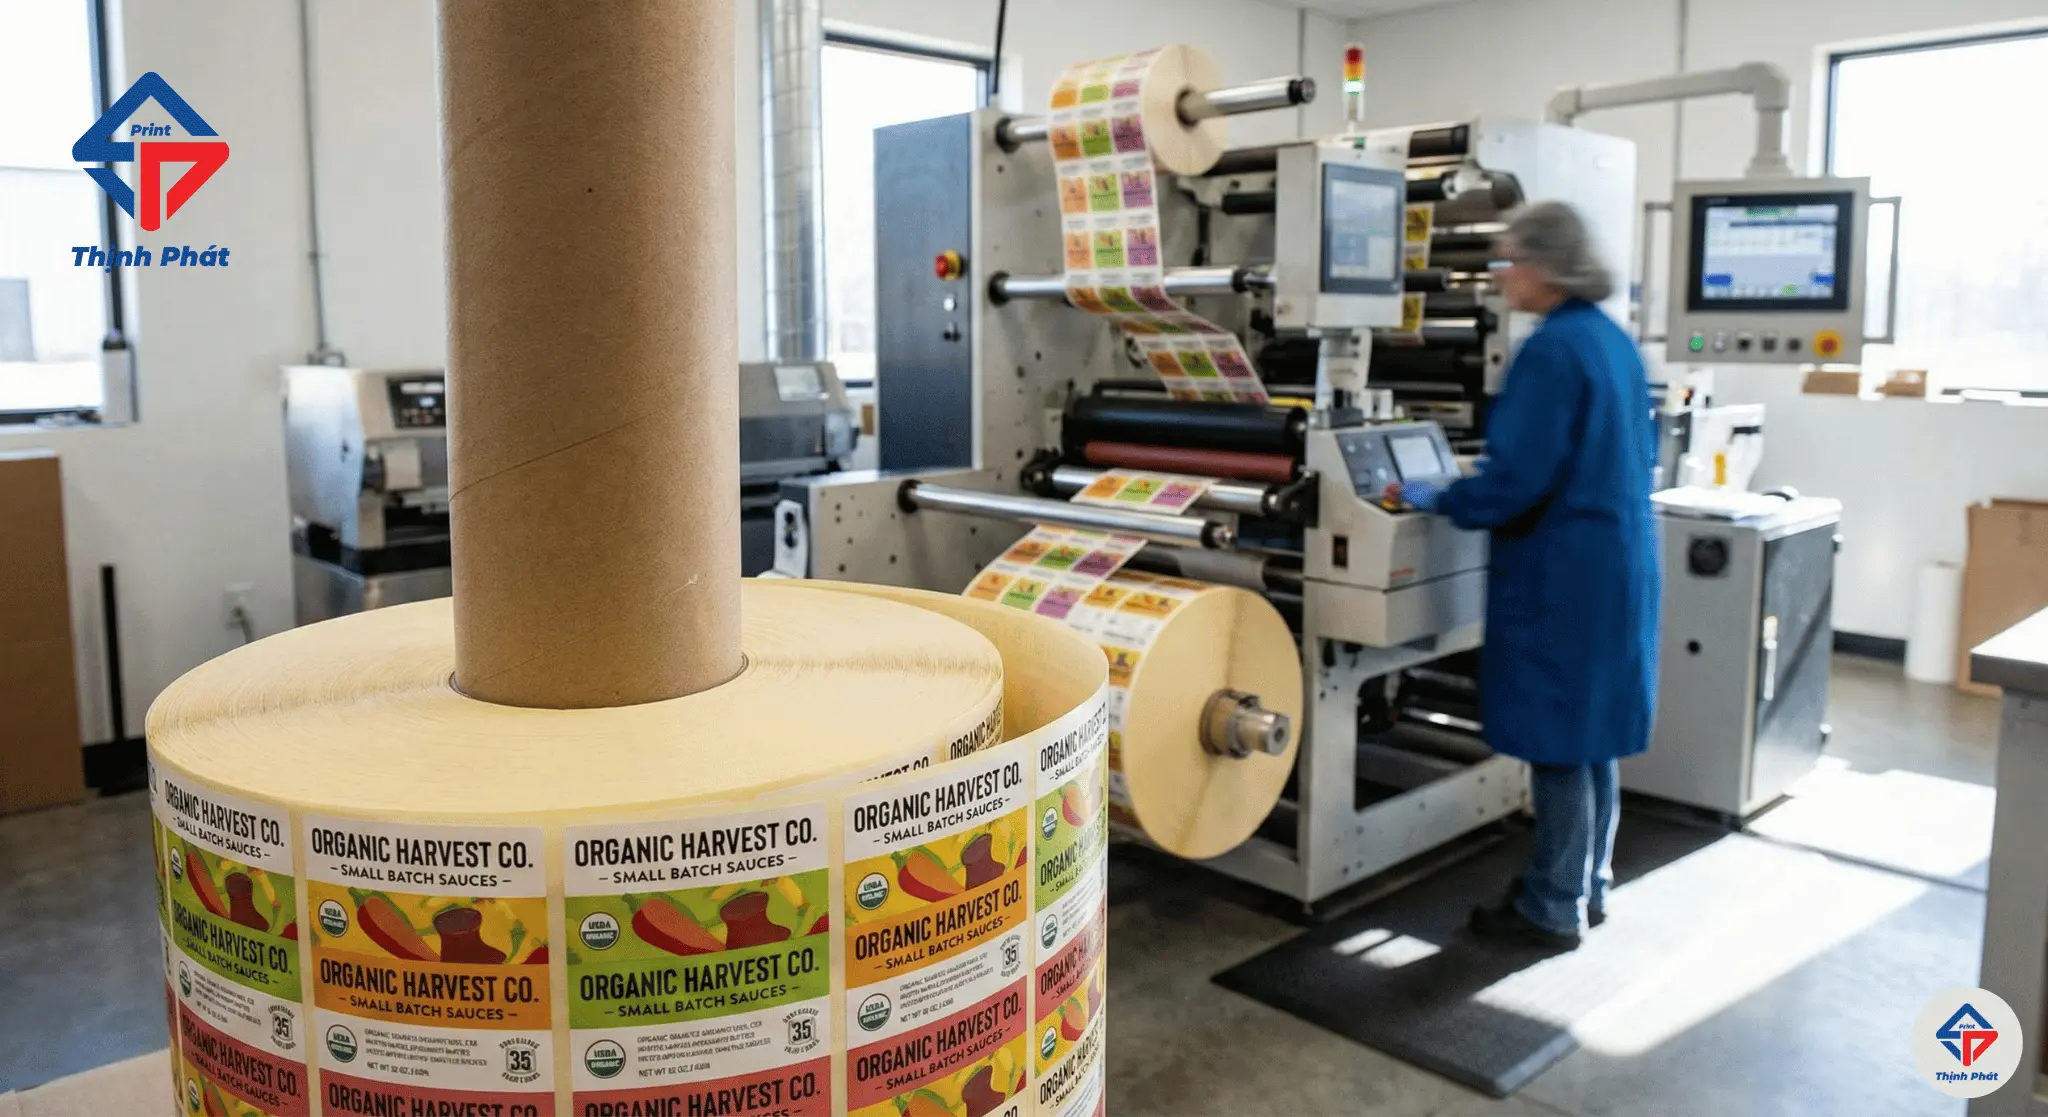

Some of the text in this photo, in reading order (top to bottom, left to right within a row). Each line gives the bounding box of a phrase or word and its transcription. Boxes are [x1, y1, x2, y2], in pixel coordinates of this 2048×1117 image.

[1041, 730, 1077, 772] ORGANIC
[165, 780, 200, 820] ORGANIC
[202, 799, 256, 840] HARVEST
[261, 818, 284, 847] CO.
[854, 792, 930, 833] ORGANIC
[936, 769, 1000, 813] HARVEST
[1004, 762, 1022, 789] CO.
[199, 828, 223, 848] BATCH
[226, 839, 262, 858] SAUCES
[574, 817, 817, 866] ORGANIC HARVEST CO.
[884, 798, 1003, 844] SMALL BATCH SAUCES
[312, 828, 533, 868] ORGANIC HARVEST CO.
[614, 854, 784, 884] SMALL BATCH SAUCES
[1041, 841, 1077, 886] ORGANIC
[341, 864, 497, 886] SMALL BATCH SAUCES
[174, 898, 292, 974] ORGANIC HARVEST CO.
[856, 880, 1022, 960] ORGANIC HARVEST CO.
[886, 916, 1004, 970] SMALL BATCH SAUCES
[1005, 946, 1018, 966] 35
[234, 964, 270, 985] SAUCES
[320, 958, 539, 1002] ORGANIC HARVEST CO.
[580, 948, 820, 1001] ORGANIC HARVEST CO.
[350, 996, 504, 1020] SMALL BATCH SAUCES
[618, 984, 786, 1016] SMALL BATCH SAUCES
[274, 1017, 289, 1038] 35
[792, 1019, 811, 1042] 35
[856, 992, 1022, 1082] ORGANIC HARVEST CO.
[220, 1044, 272, 1088] HARVEST
[278, 1068, 300, 1098] CO.
[510, 1050, 532, 1071] 35
[886, 1028, 1003, 1091] SMALL BATCH SAUCES
[1040, 1054, 1076, 1105] ORGANIC
[244, 1082, 280, 1107] SAUCES
[329, 1082, 404, 1117] ORGANIC
[688, 1078, 784, 1117] HARVEST
[790, 1072, 822, 1100] CO.
